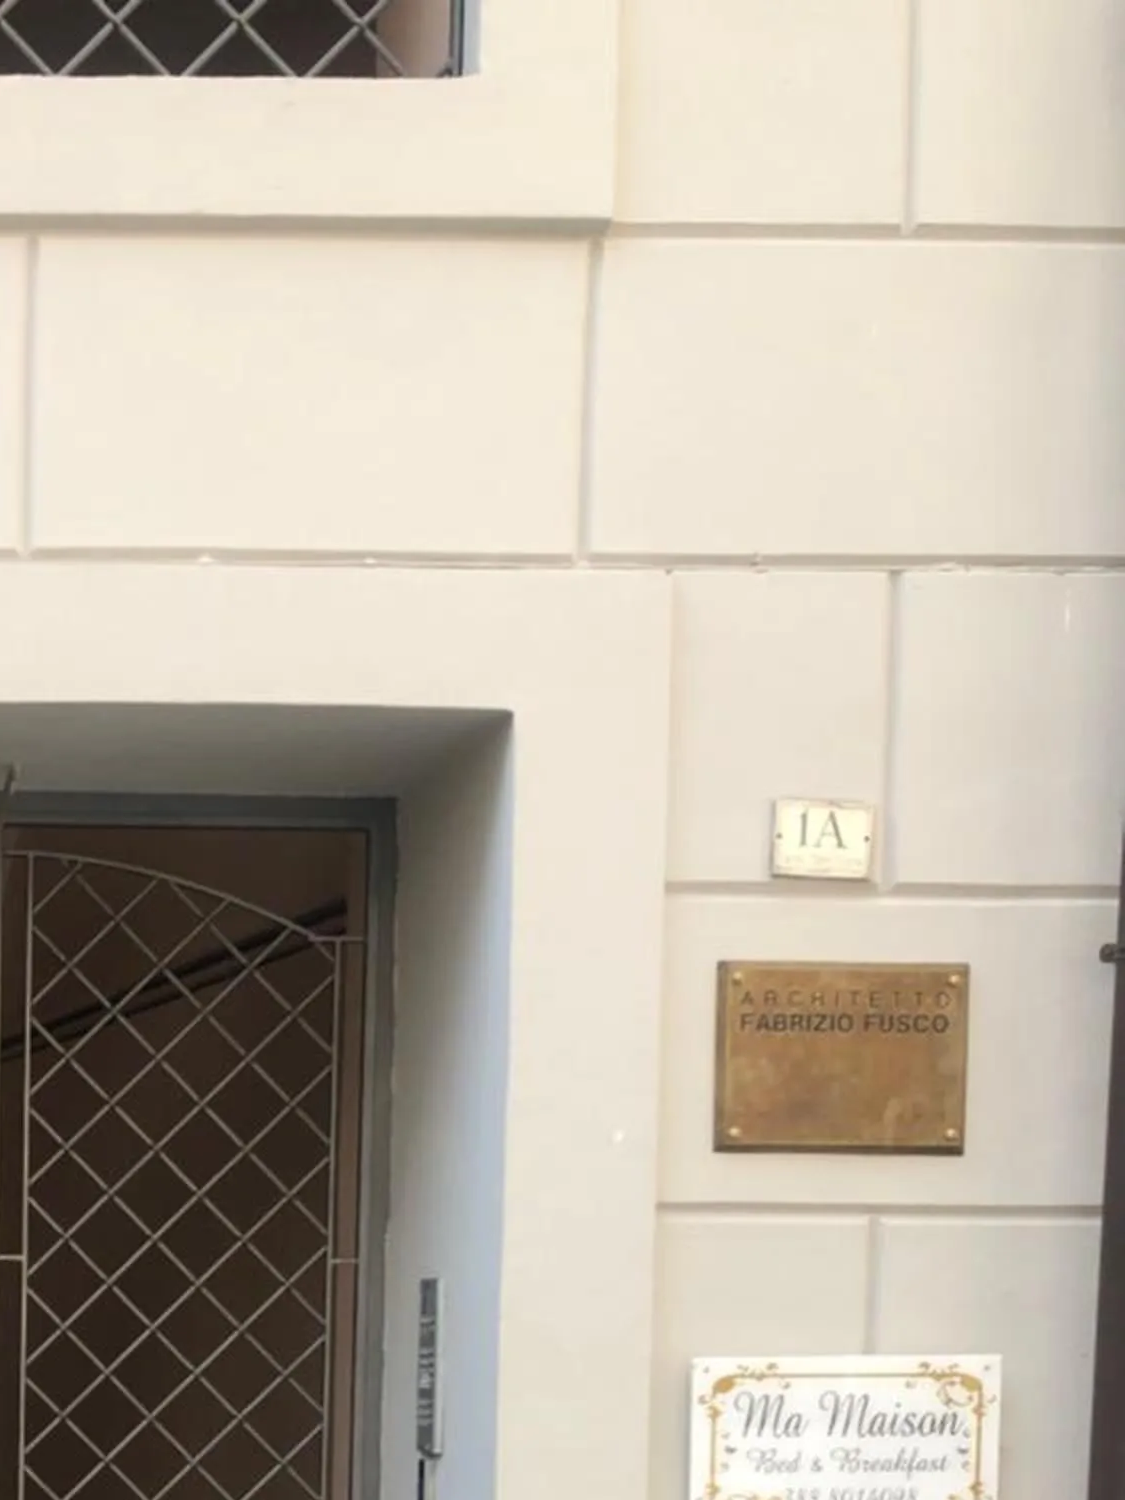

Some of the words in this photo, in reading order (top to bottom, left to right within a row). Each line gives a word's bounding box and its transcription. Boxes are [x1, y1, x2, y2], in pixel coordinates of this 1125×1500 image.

[740, 989, 954, 1010] ARCHITETTO
[739, 1013, 855, 1034] FABRIZIO
[863, 1013, 951, 1035] FUSCO
[733, 1390, 810, 1438] Ma
[818, 1390, 964, 1438] Maison
[746, 1448, 802, 1474] Bed
[810, 1455, 823, 1473] &
[829, 1447, 948, 1480] Breakfast
